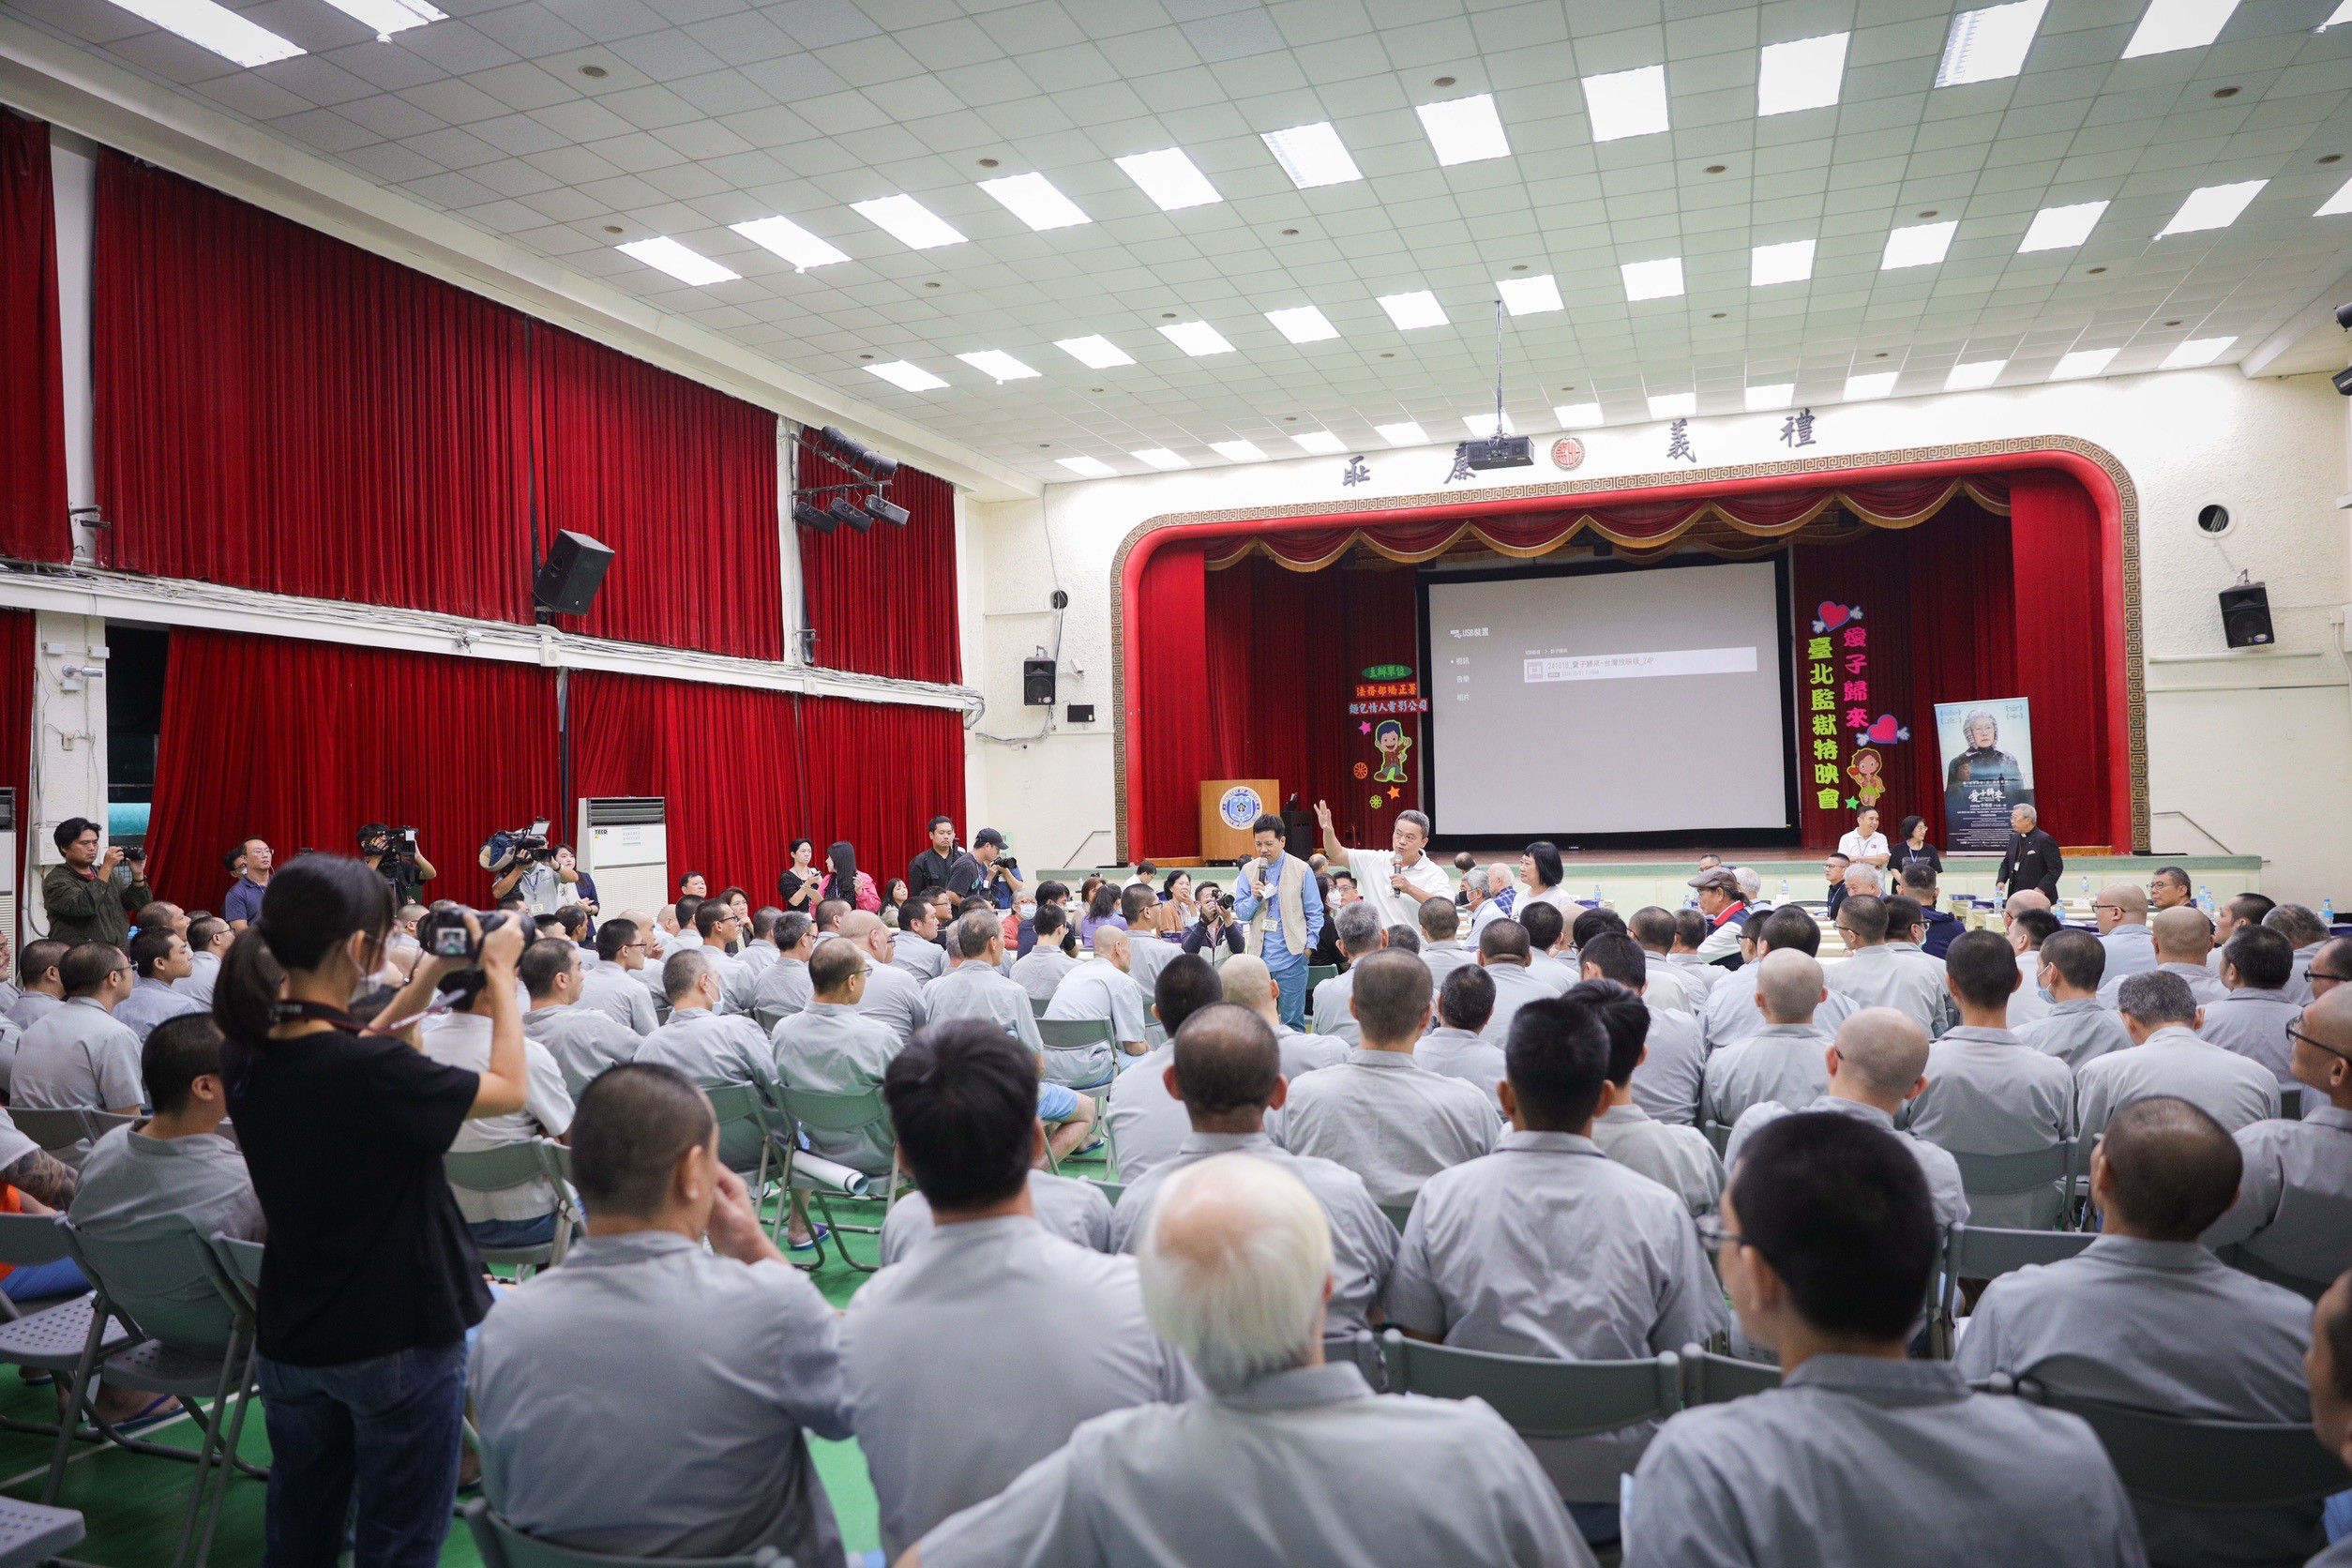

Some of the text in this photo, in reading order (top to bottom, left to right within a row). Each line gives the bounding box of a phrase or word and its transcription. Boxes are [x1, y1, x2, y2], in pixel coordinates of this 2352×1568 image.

[1666, 418, 1696, 463] 義
[1780, 408, 1817, 448] 禮
[1356, 683, 1417, 697] 法務部矯正署
[1369, 665, 1406, 678] 主辦單位
[1843, 626, 1869, 728] 愛子歸來
[1349, 699, 1427, 715] 麵包情人電影公司
[1808, 637, 1840, 809] 臺北監獄特映會
